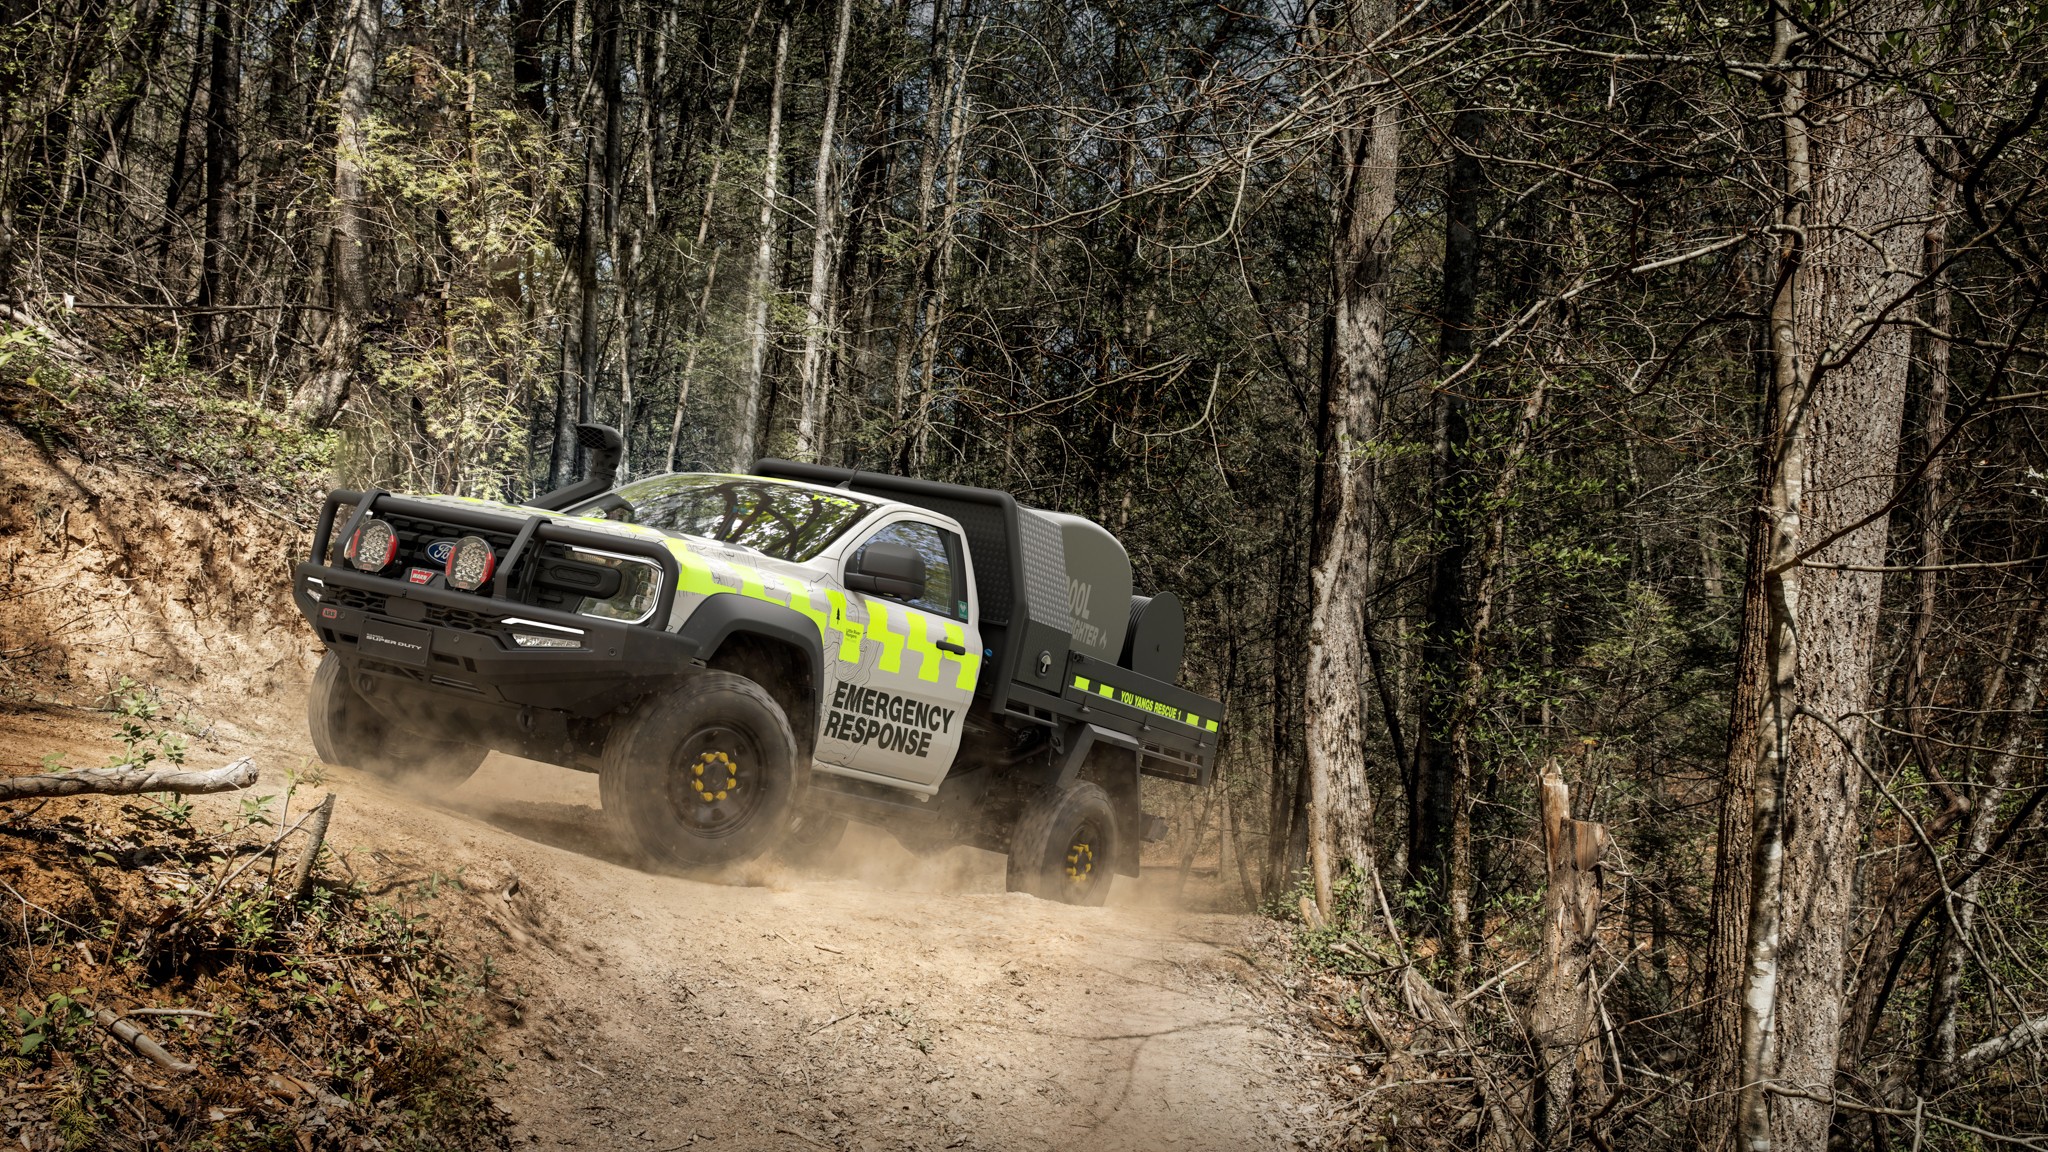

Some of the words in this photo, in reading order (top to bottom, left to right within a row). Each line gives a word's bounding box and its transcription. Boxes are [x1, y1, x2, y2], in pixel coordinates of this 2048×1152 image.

[412, 573, 429, 581] WARN
[366, 635, 397, 645] SUPER
[397, 641, 422, 650] DUTY
[1070, 617, 1099, 647] IGHTER
[832, 680, 955, 734] EMERGENCY
[1121, 690, 1134, 704] YOU
[1135, 695, 1154, 711] YANGS
[1154, 702, 1177, 719] RESCUE
[1177, 710, 1182, 721] 1
[823, 710, 932, 758] RESPONSE
